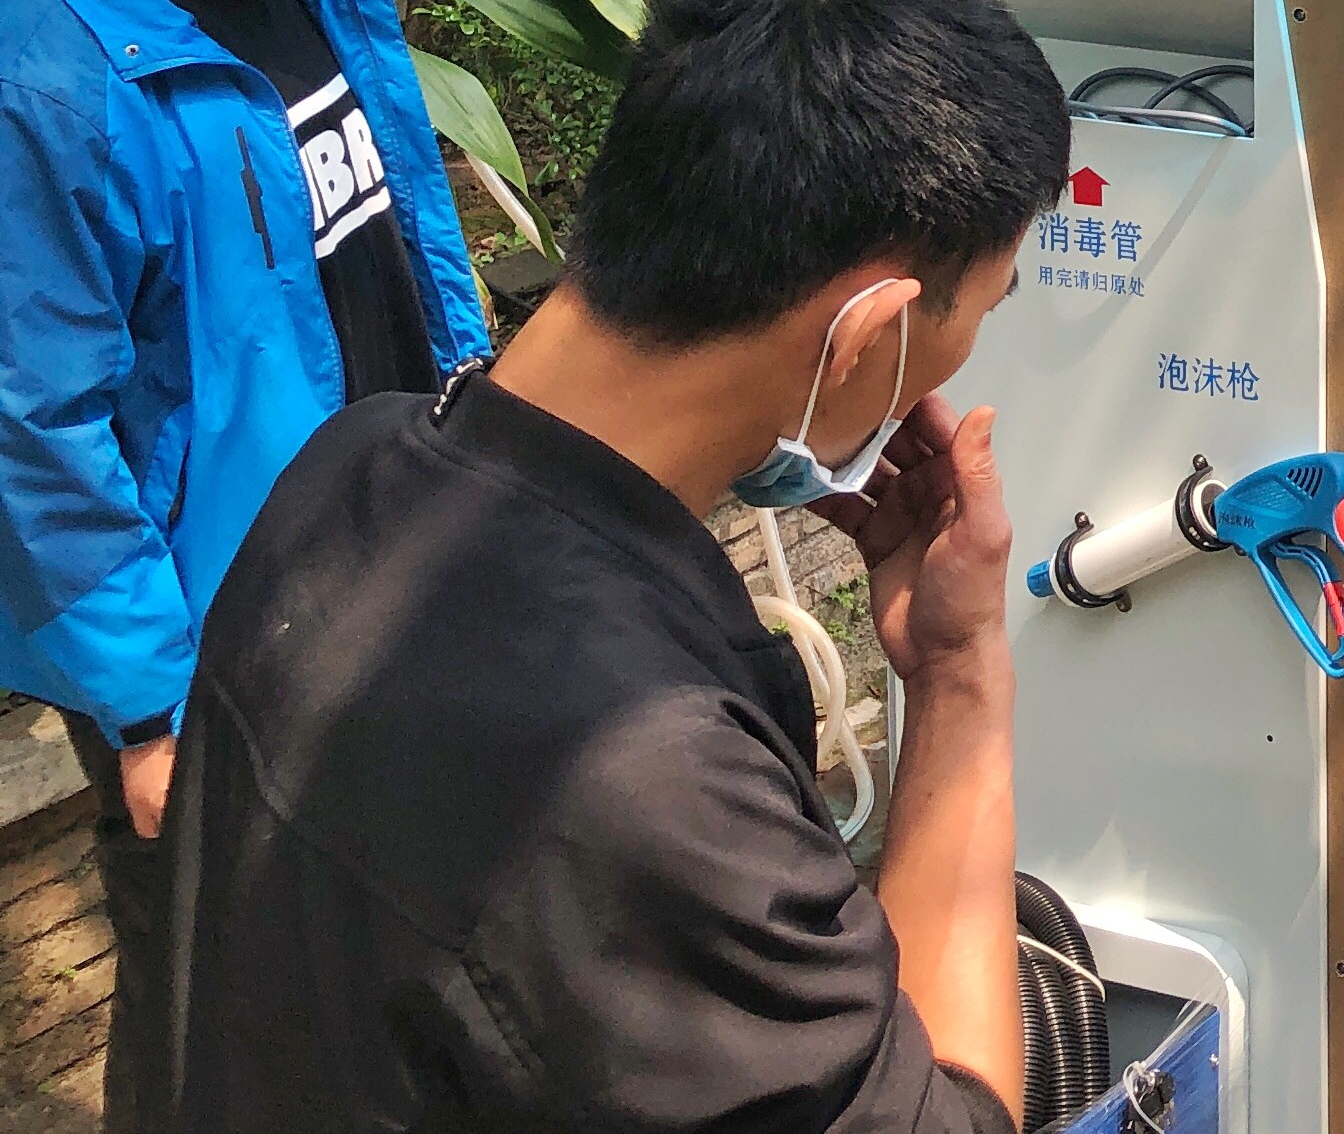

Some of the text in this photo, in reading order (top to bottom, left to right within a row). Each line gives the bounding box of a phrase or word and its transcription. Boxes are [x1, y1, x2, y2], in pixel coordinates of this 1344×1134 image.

[1038, 212, 1142, 262] 消毒管
[1037, 264, 1145, 298] 用完请归原处
[1157, 352, 1260, 402] 泡沫枪
